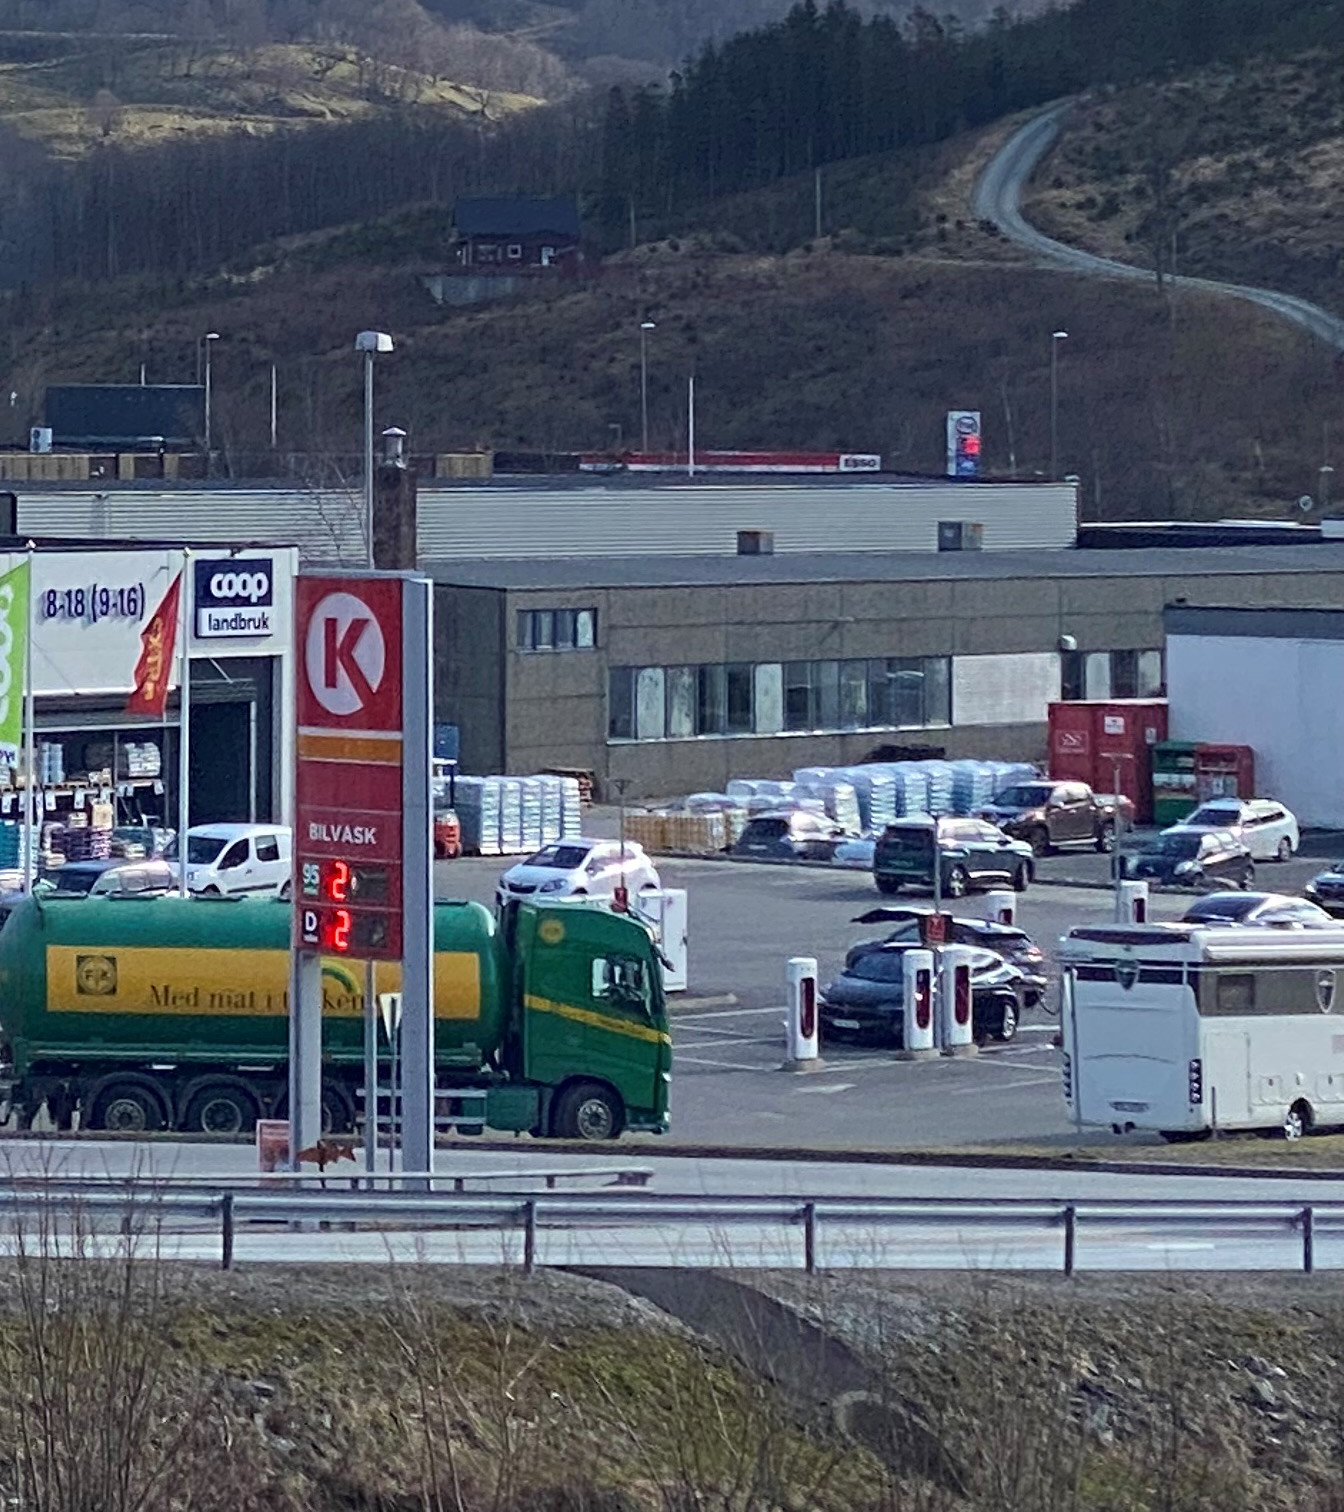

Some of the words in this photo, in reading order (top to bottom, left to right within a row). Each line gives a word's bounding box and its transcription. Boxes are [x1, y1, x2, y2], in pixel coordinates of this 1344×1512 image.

[210, 572, 269, 603] coop
[46, 588, 85, 618] 8-18
[91, 582, 146, 623] (9-16)
[208, 611, 270, 632] landbruk
[324, 617, 376, 706] K
[308, 822, 377, 845] BILVASK
[302, 862, 320, 885] 95
[305, 910, 318, 932] D
[147, 983, 199, 1009] Med
[210, 987, 256, 1011] mat
